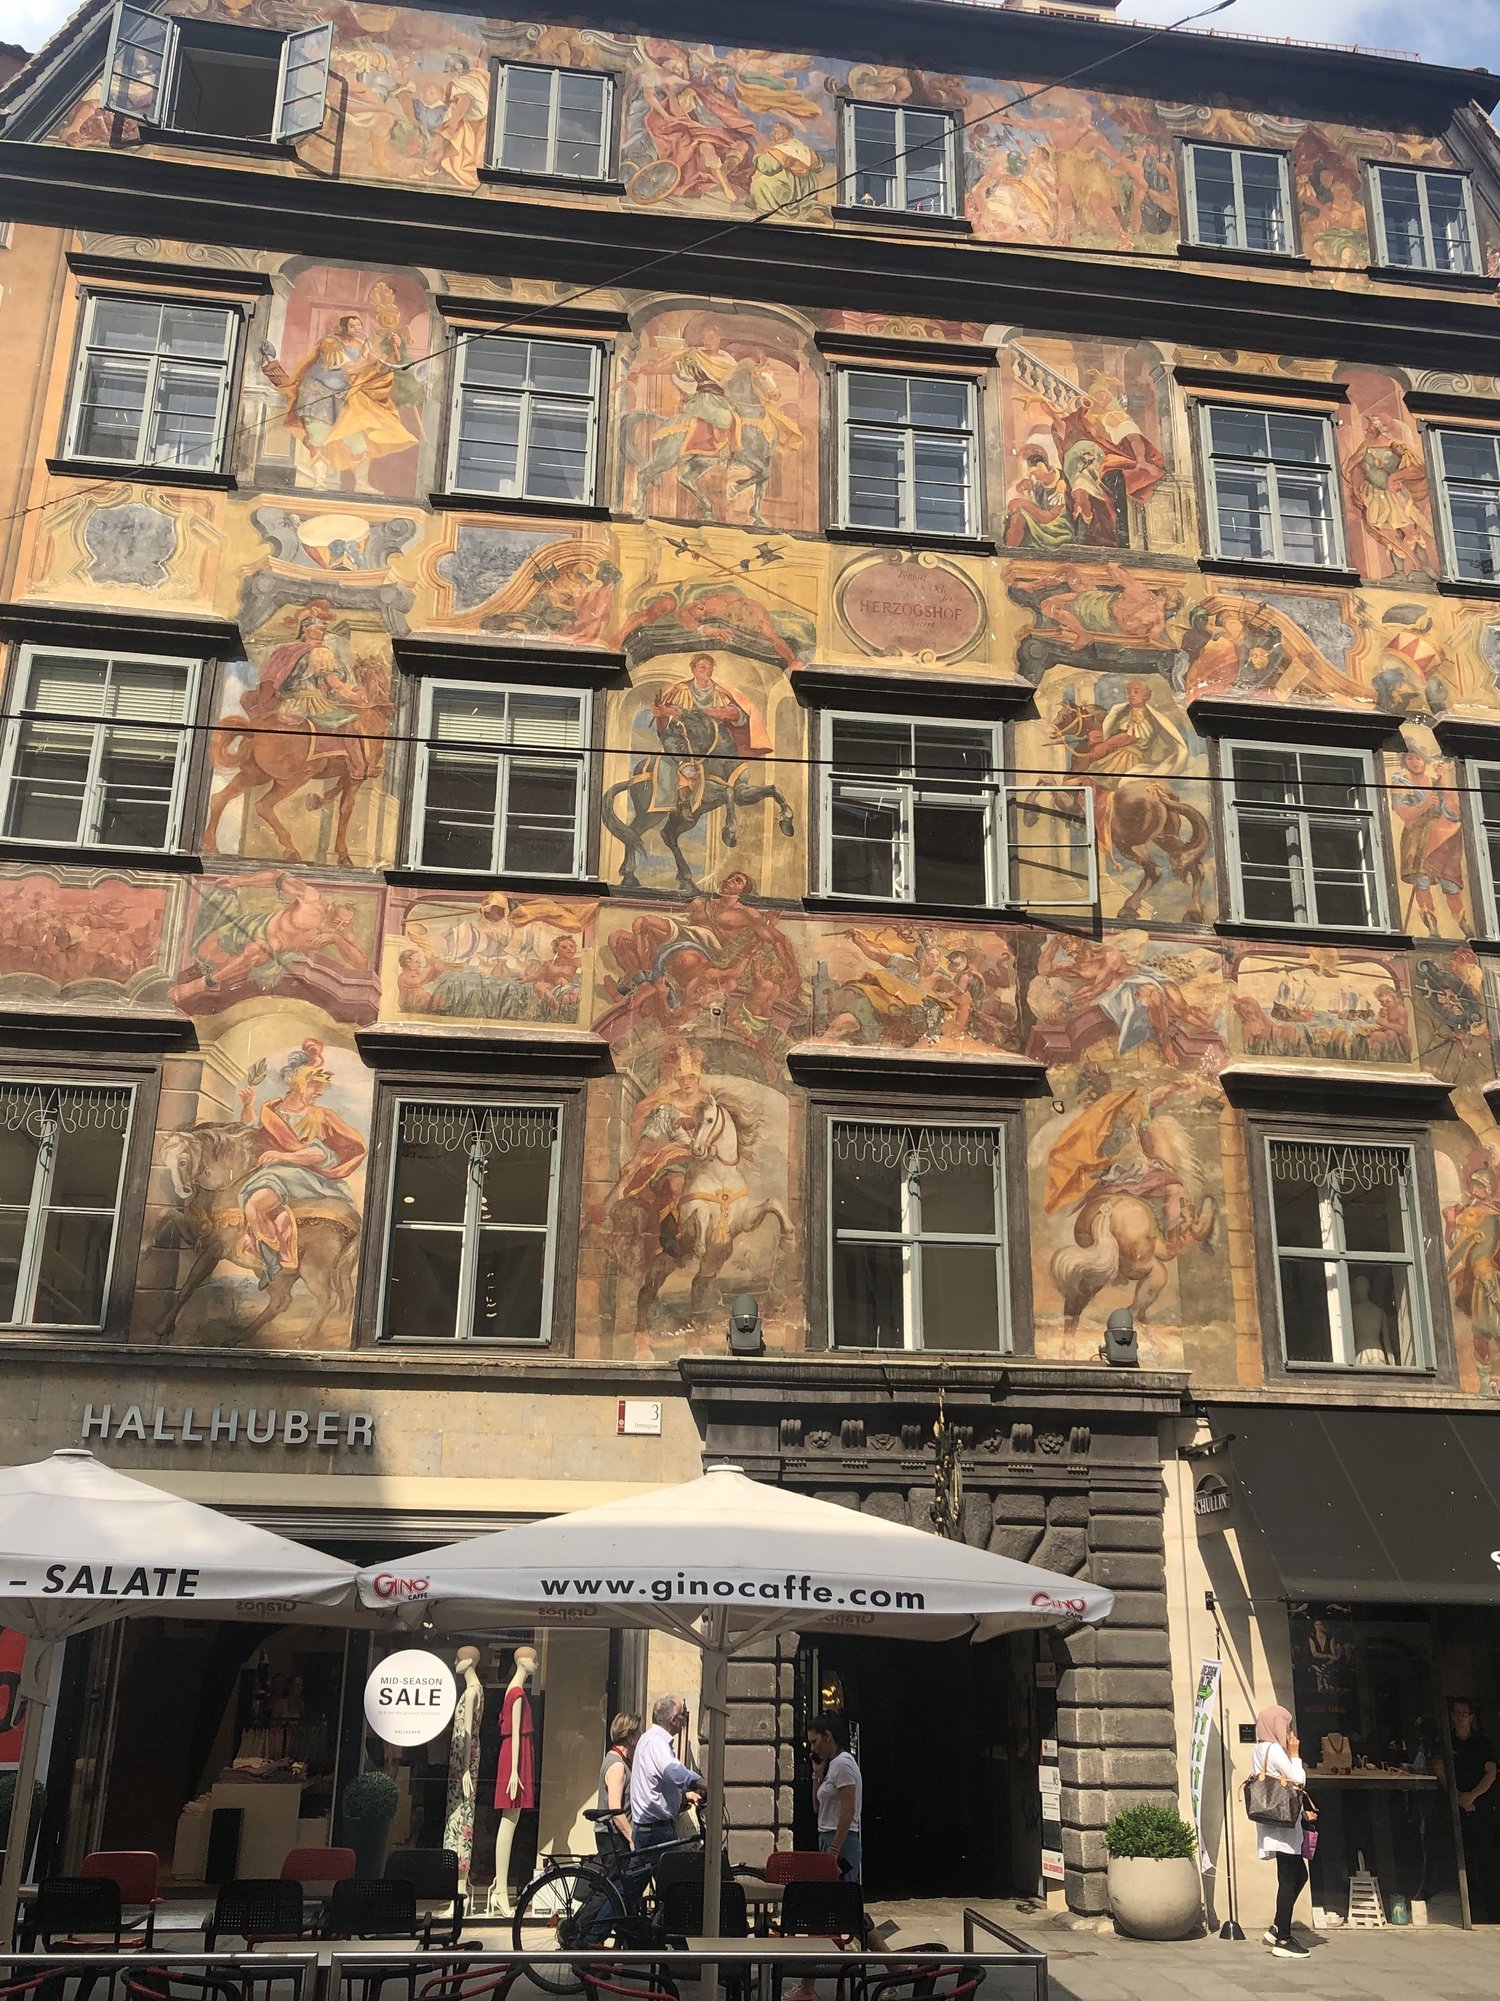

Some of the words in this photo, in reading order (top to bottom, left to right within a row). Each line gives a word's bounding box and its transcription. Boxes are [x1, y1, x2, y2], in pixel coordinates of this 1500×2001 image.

[860, 600, 962, 620] HERZOGSHOF
[651, 1404, 659, 1420] 3
[81, 1403, 375, 1446] HALLHUBER
[42, 1564, 200, 1597] SALATE
[541, 1572, 924, 1610] www.ginocaffe.com
[380, 1677, 443, 1686] MID-SEASON
[378, 1687, 442, 1707] SALE
